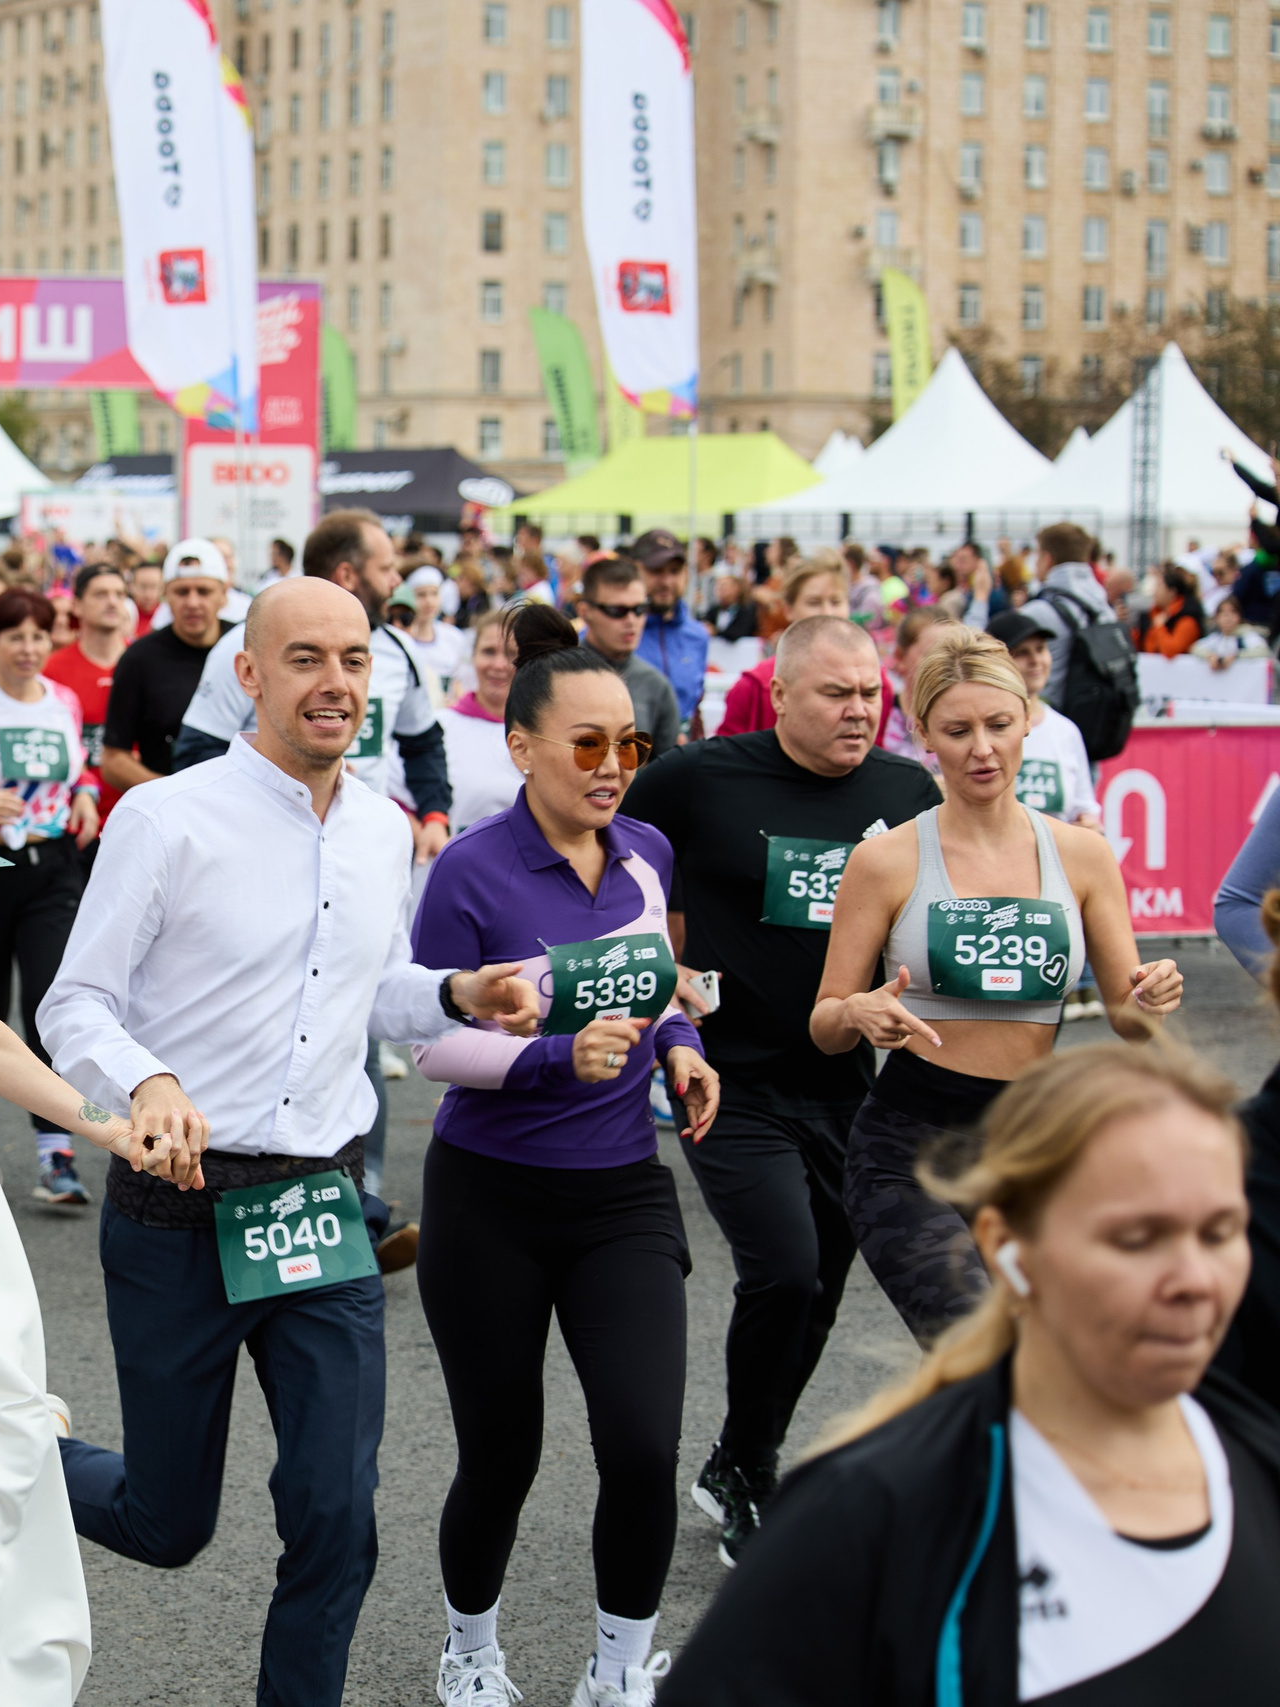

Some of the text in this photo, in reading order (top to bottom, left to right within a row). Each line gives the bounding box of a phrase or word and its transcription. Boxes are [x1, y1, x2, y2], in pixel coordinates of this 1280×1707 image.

[787, 870, 843, 901] 533
[1024, 913, 1034, 924] 5
[633, 949, 641, 960] 5
[954, 934, 1048, 967] 5239
[574, 971, 657, 1010] 5339
[990, 976, 1014, 984] BBDO
[311, 1190, 321, 1203] 5
[244, 1212, 342, 1262] 5040
